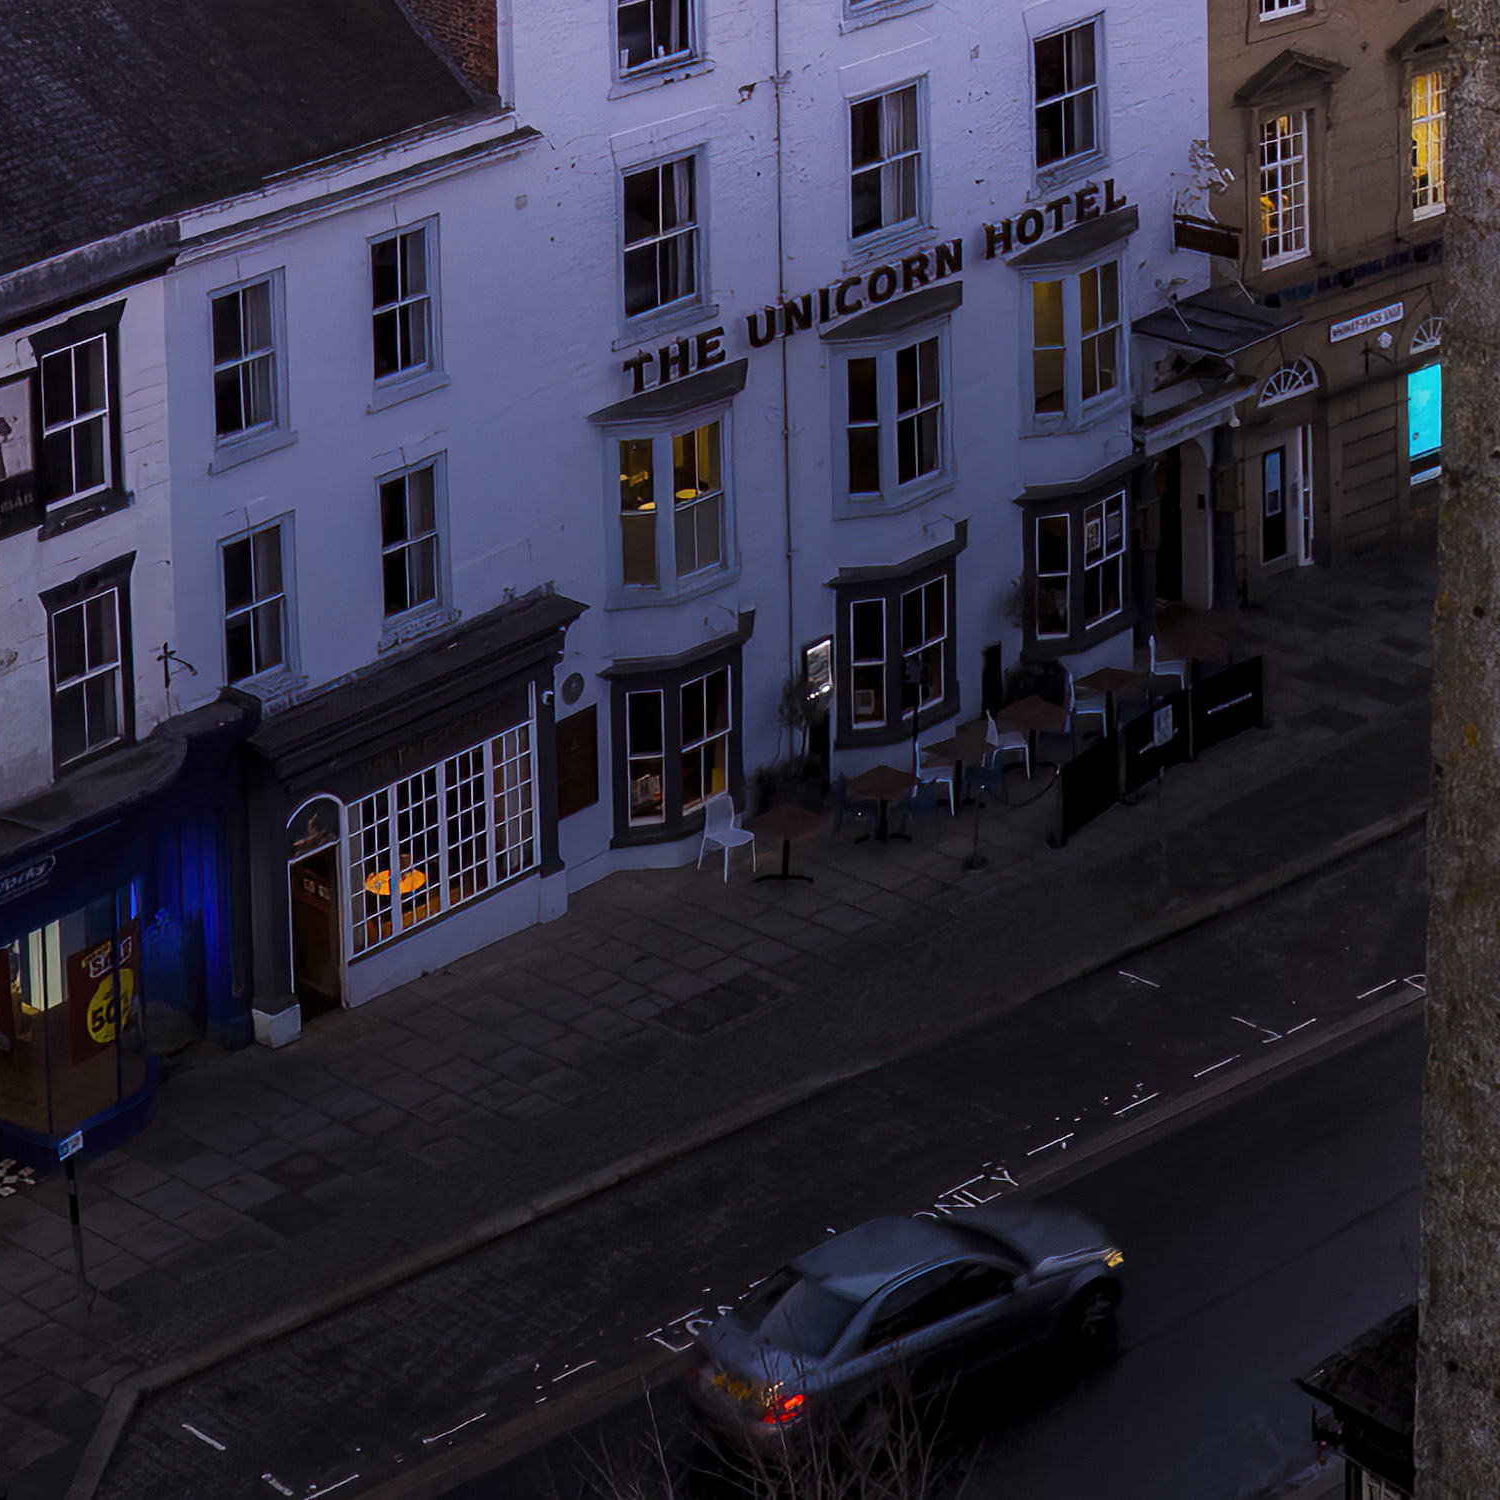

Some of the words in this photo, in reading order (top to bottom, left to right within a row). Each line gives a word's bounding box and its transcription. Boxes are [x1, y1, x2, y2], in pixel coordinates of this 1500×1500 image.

[622, 326, 726, 394] THE
[746, 239, 963, 349] UNICORN
[984, 178, 1127, 260] HOTEL
